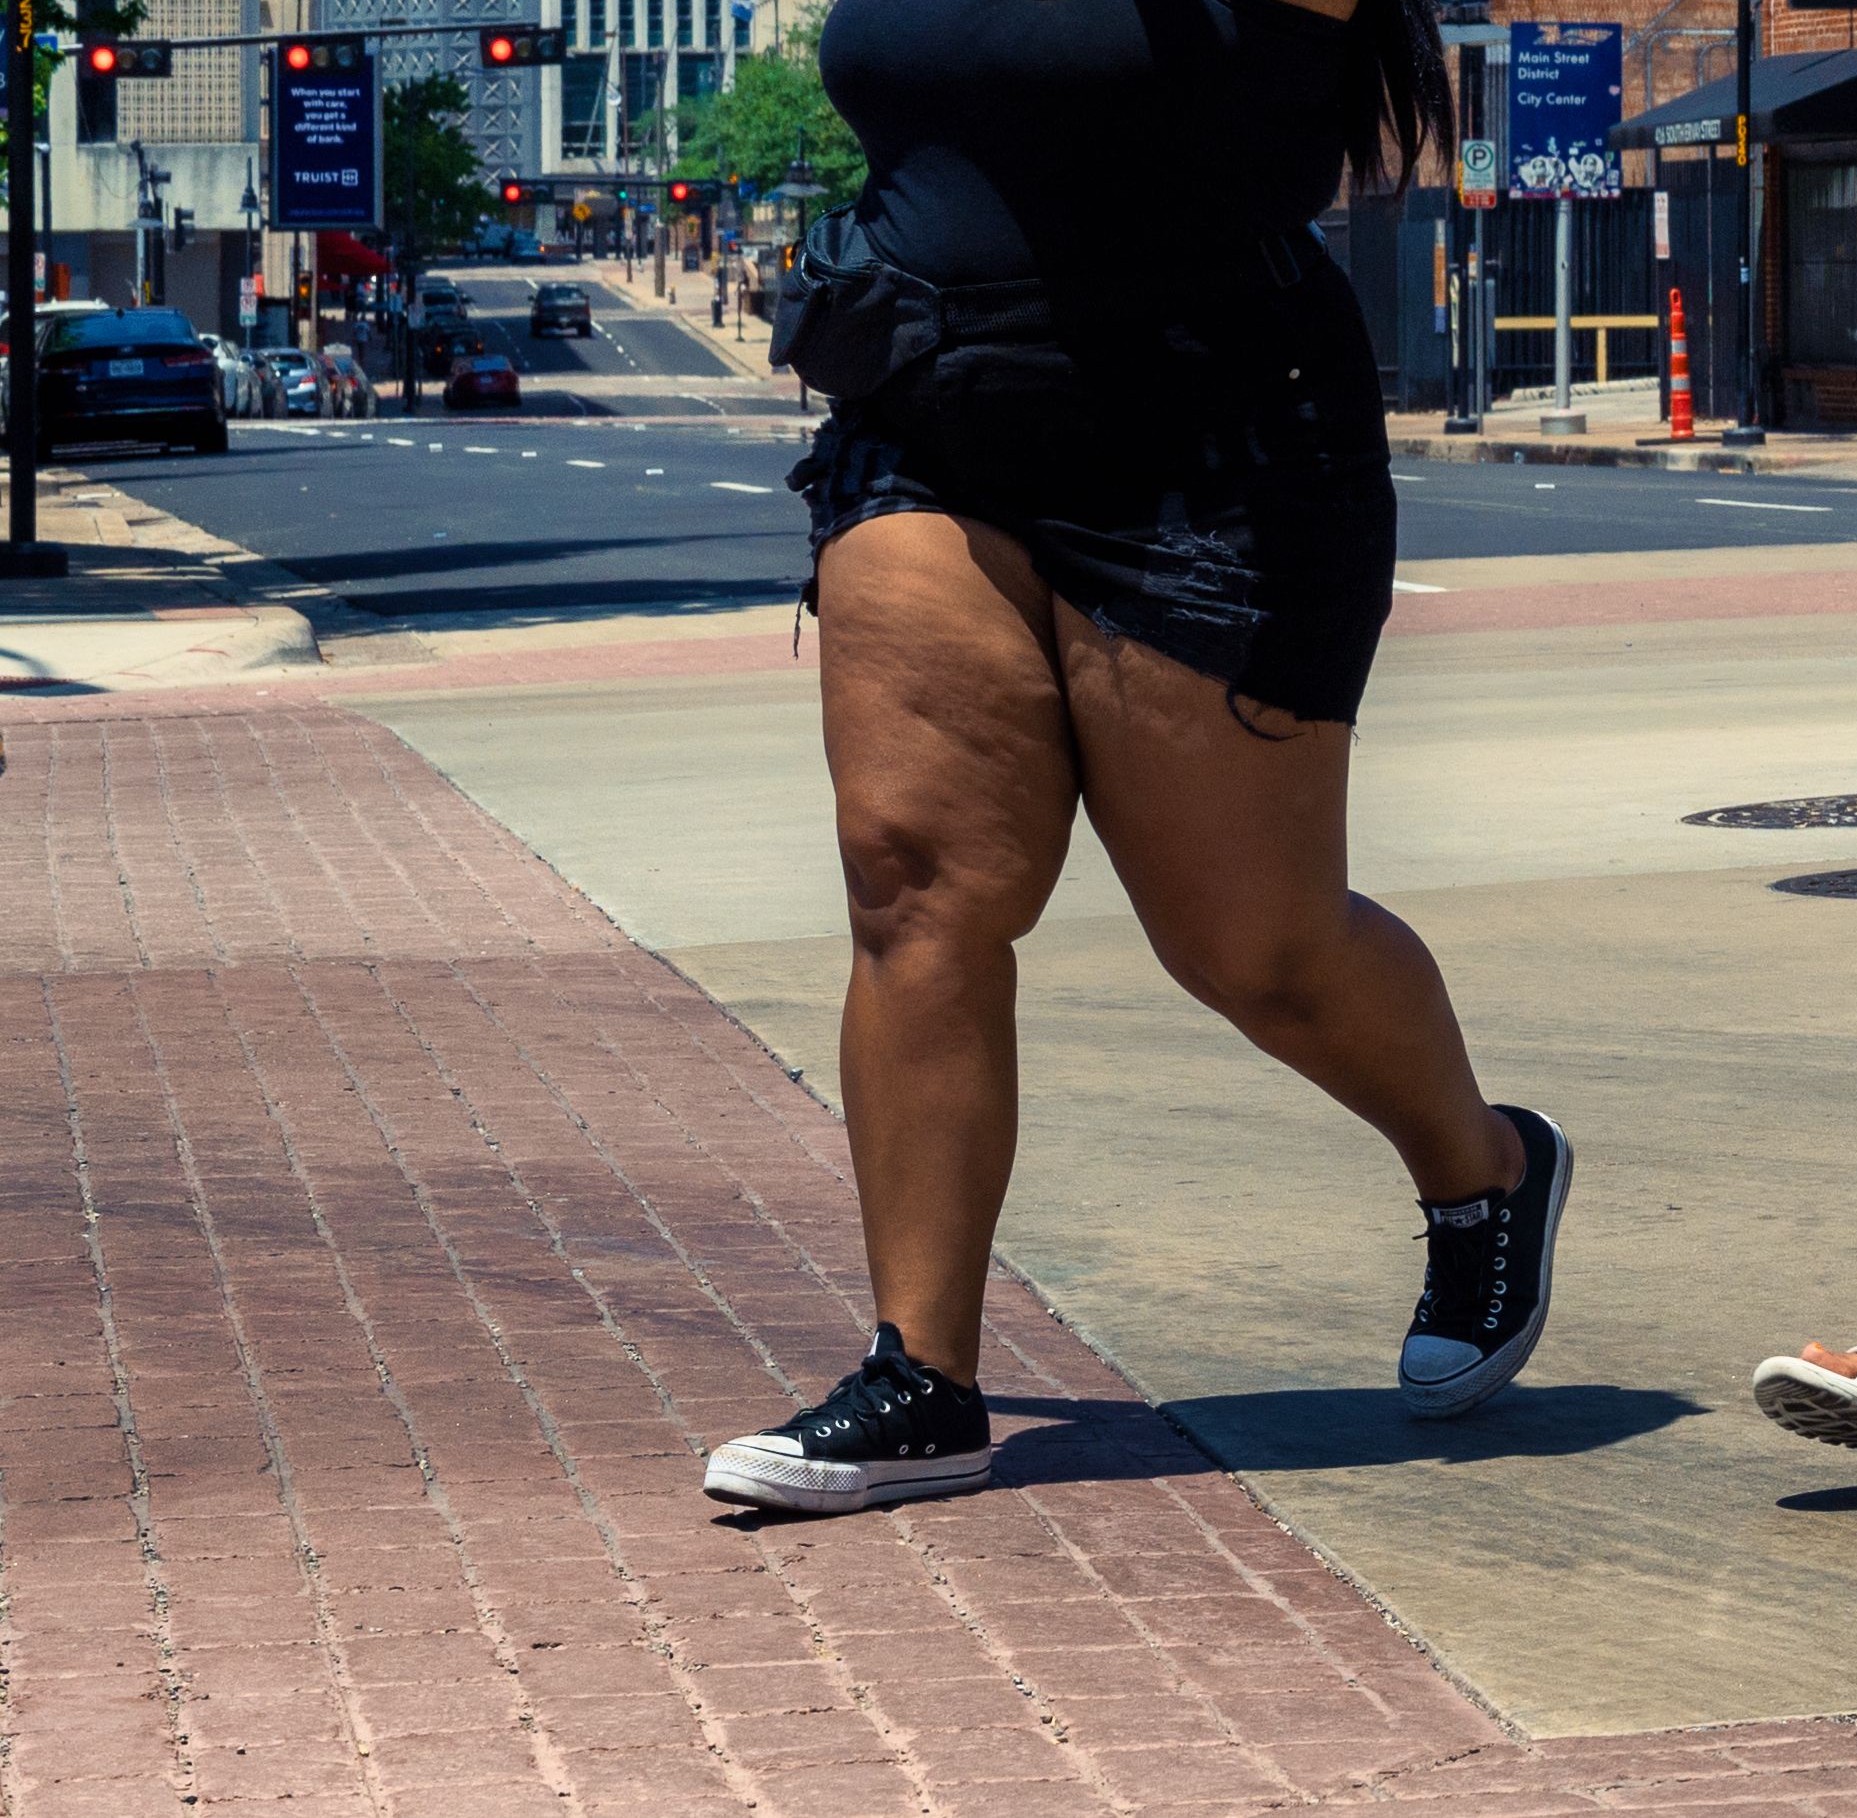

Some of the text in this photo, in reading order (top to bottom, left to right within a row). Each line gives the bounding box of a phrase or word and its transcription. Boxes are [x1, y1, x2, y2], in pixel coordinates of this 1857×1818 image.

[1518, 51, 1590, 64] Main Street
[1518, 67, 1559, 80] District
[291, 88, 360, 98] When you start
[303, 99, 324, 108] with
[1517, 92, 1586, 108] City Center
[305, 112, 322, 121] you
[306, 134, 317, 143] of
[1472, 148, 1487, 166] P
[294, 171, 340, 183] TRUIST
